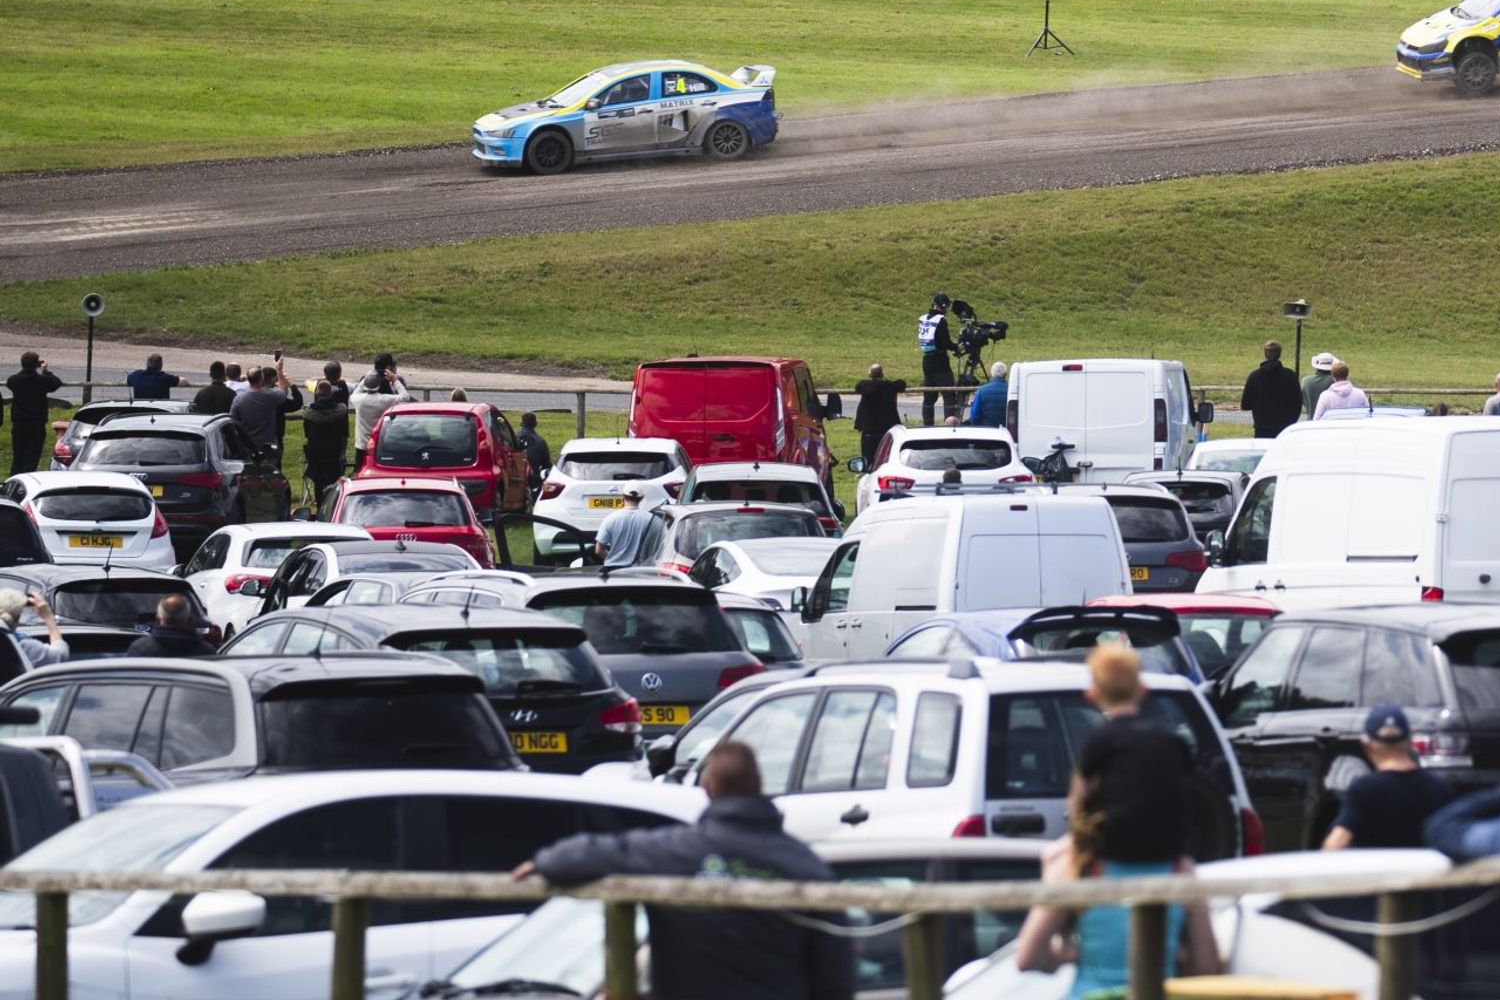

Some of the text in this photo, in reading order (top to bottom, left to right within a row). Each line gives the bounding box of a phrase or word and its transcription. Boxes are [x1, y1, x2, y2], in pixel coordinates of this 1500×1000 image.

[676, 77, 686, 94] 4
[660, 100, 694, 109] MATRIX
[656, 707, 675, 722] 90
[528, 734, 559, 750] NGG
